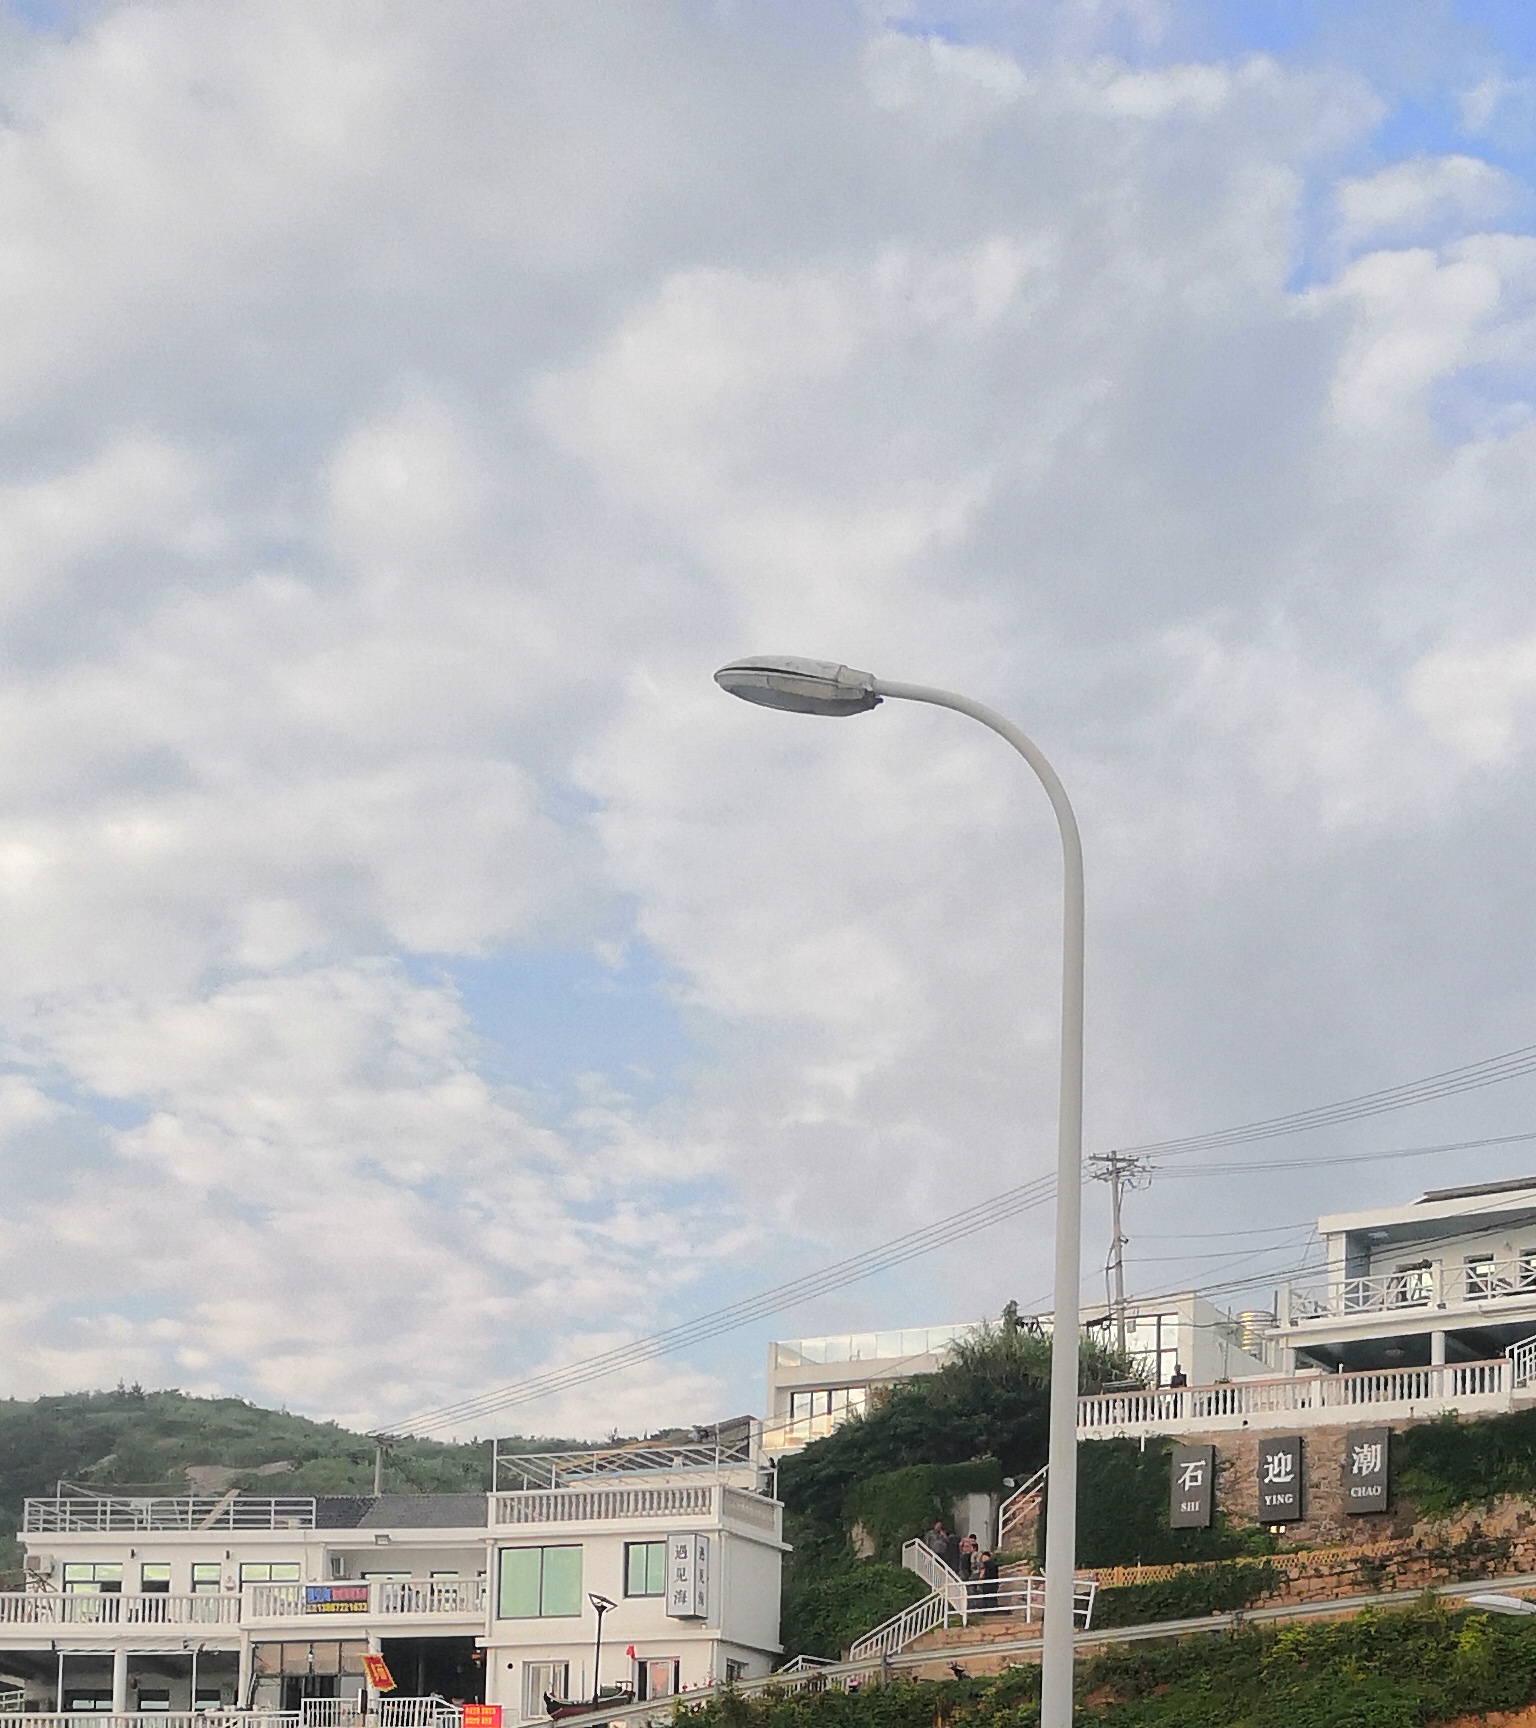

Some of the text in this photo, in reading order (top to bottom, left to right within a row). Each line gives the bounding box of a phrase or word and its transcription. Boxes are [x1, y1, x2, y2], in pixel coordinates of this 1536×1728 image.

[1264, 1451, 1295, 1484] 迎
[1352, 1444, 1382, 1477] 潮
[1178, 1460, 1206, 1491] 石
[1265, 1493, 1293, 1506] YING
[1350, 1485, 1381, 1498] CHAO
[1180, 1501, 1200, 1512] SHI
